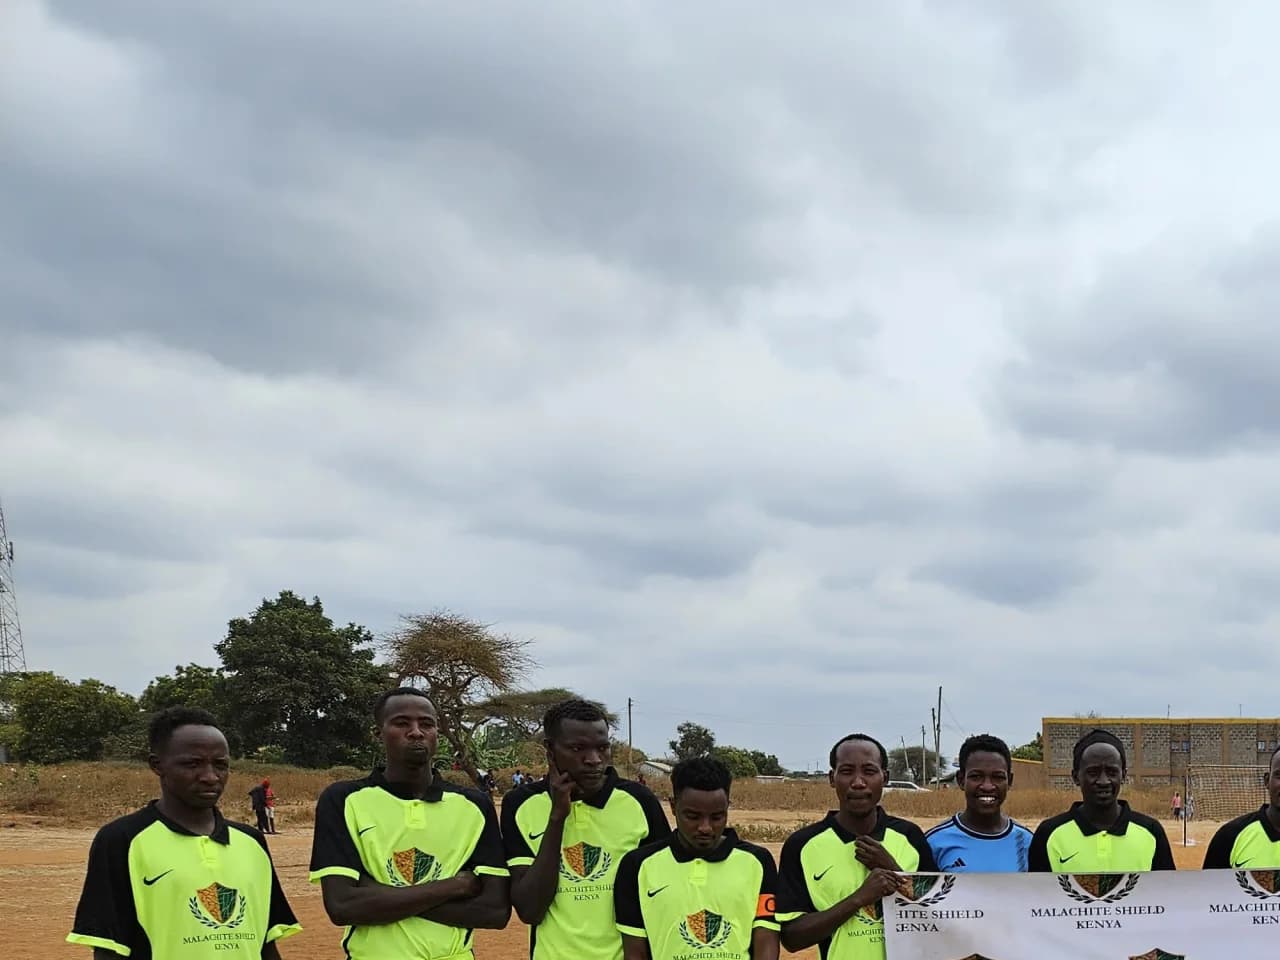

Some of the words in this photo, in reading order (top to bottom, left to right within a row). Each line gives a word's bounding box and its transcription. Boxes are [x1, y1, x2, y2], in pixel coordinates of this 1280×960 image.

[574, 893, 600, 901] KENYA
[931, 909, 984, 919] SHIELD
[1031, 907, 1112, 917] MALACHITE
[1115, 905, 1165, 915] SHIELD
[1076, 920, 1121, 929] KENYA
[182, 933, 234, 945] MALACHITE
[235, 932, 256, 941] SHIELD
[214, 943, 241, 951] KENYA
[716, 952, 741, 960] SHIELD
